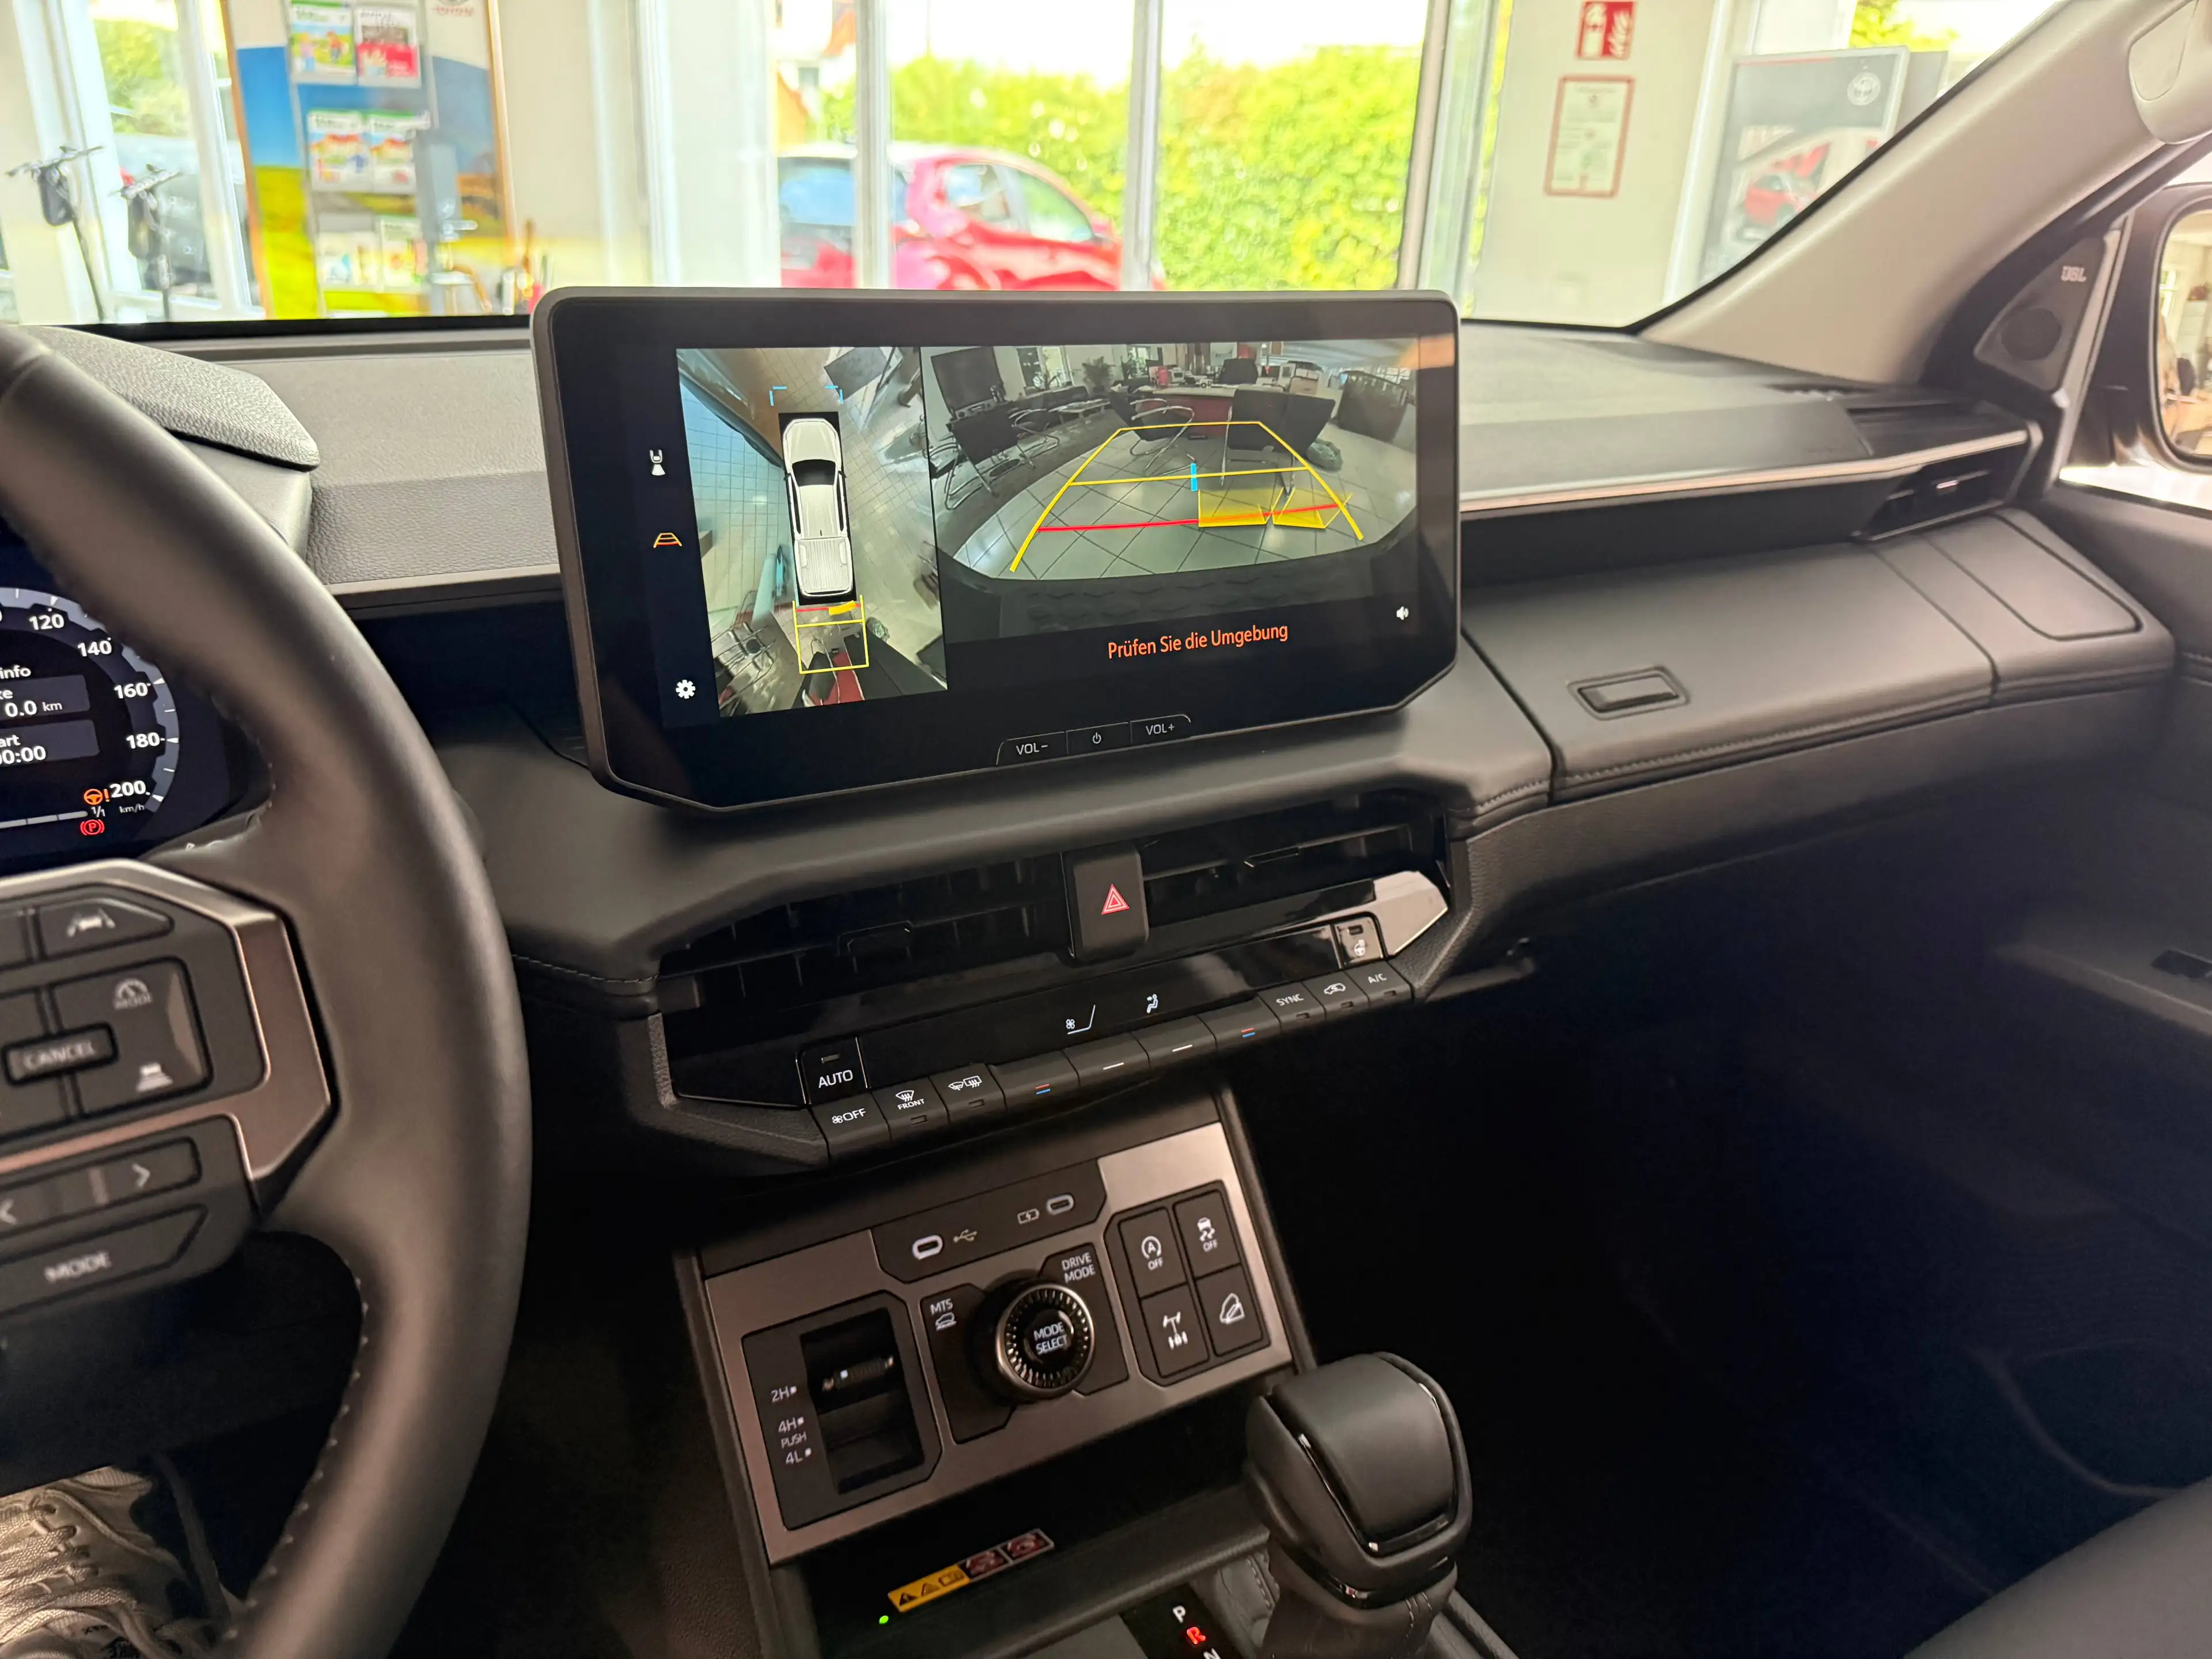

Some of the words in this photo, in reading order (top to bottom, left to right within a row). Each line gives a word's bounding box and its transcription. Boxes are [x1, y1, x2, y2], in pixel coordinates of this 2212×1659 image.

[29, 613, 65, 630] 120
[77, 640, 112, 657] 140
[1108, 638, 1157, 659] Prüfen
[1160, 635, 1181, 653] Sie
[1185, 632, 1207, 649] die
[1211, 624, 1289, 647] Umgebung
[0, 664, 32, 680] info
[113, 682, 149, 699] 160
[5, 700, 37, 718] 0.0
[41, 702, 63, 712] km
[126, 732, 161, 749] 180
[109, 780, 146, 798] 200
[119, 803, 145, 813] km/h
[1368, 973, 1387, 984] A/C
[1276, 994, 1304, 1007] SYNC
[23, 1039, 96, 1071] CANCEL
[818, 1069, 854, 1089] AUTO
[897, 1098, 925, 1111] FRONT
[843, 1108, 866, 1122] OFF
[1203, 1239, 1218, 1252] OFF
[44, 1251, 112, 1284] MODE
[1061, 1252, 1092, 1270] DRIVE
[1148, 1257, 1163, 1271] OFF
[1064, 1264, 1096, 1283] MODE
[930, 1298, 953, 1315] MTS
[1033, 1321, 1065, 1342] MODE
[1036, 1334, 1068, 1355] SELECT
[771, 1386, 790, 1403] 2H
[778, 1417, 797, 1433] 4H
[781, 1431, 807, 1449] PUSH
[785, 1449, 804, 1464] 4L
[1173, 1605, 1186, 1623] P
[1187, 1626, 1206, 1645] R
